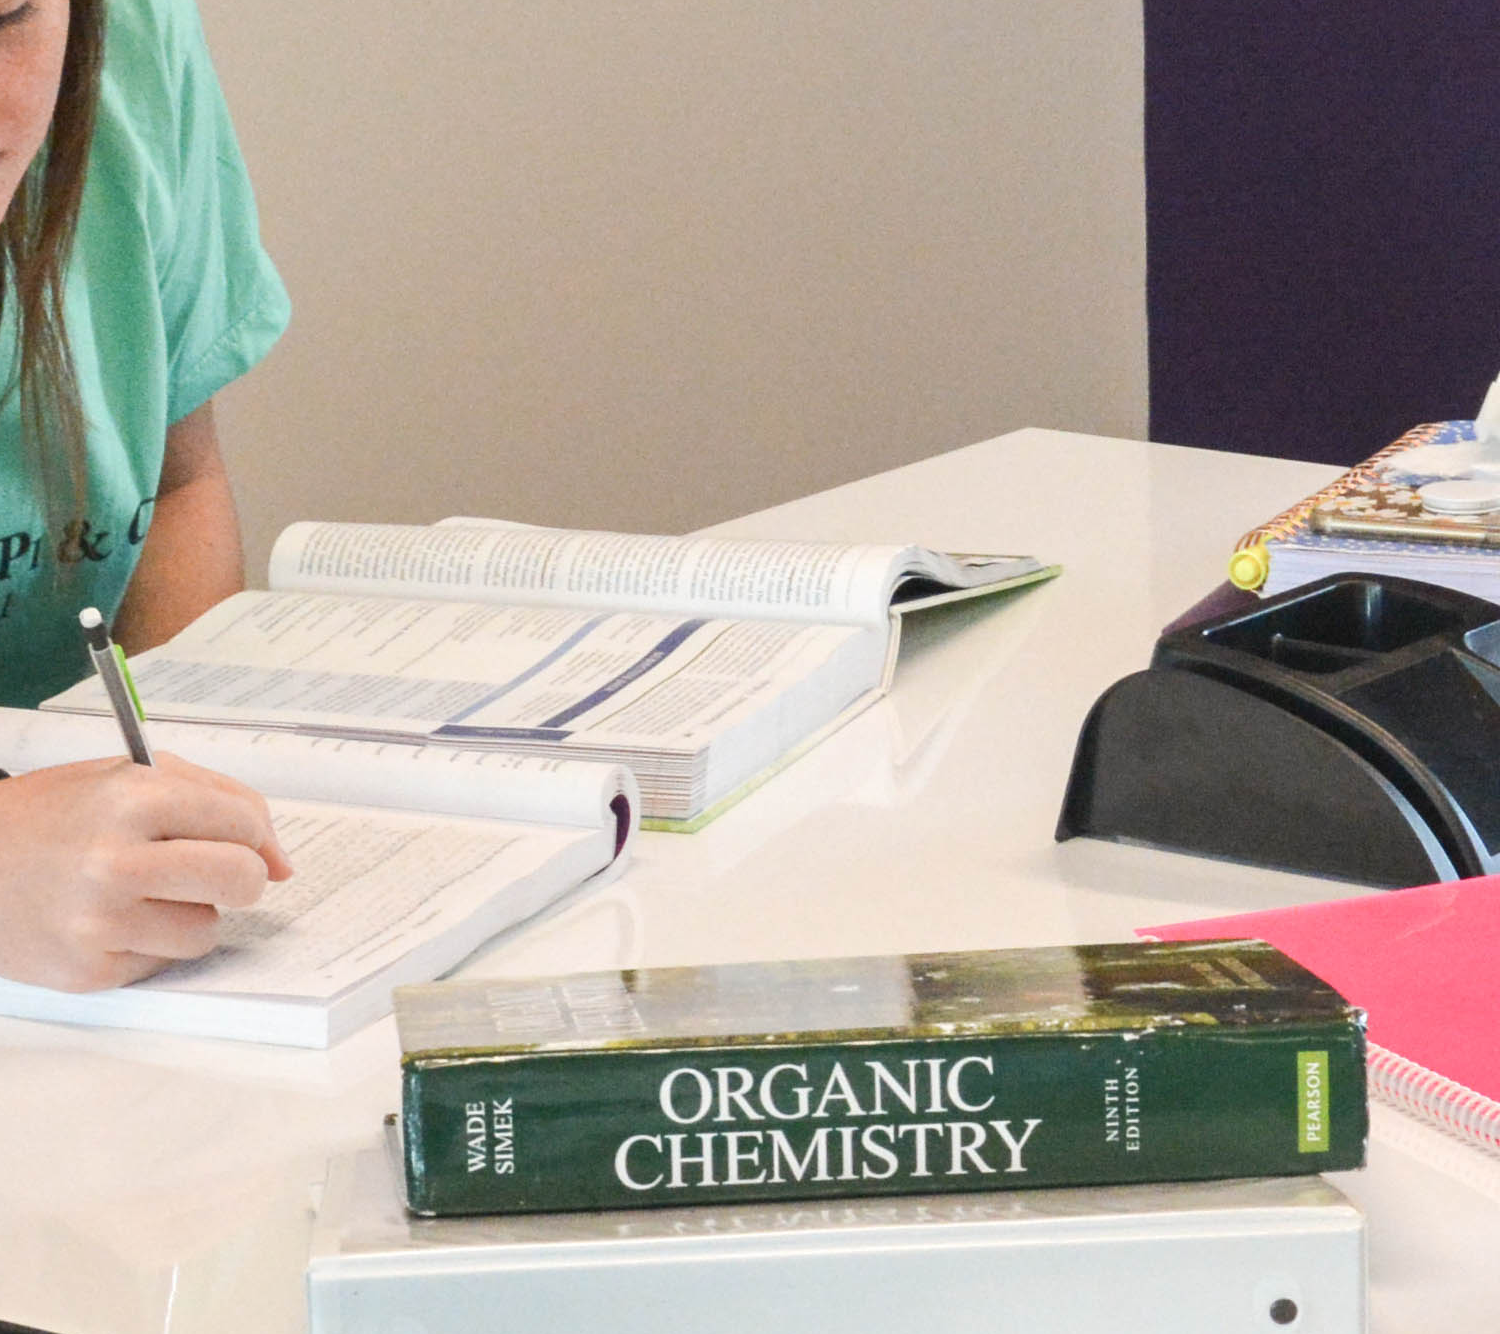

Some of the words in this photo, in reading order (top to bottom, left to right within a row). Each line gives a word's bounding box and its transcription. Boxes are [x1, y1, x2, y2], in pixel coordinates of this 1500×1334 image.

[658, 1056, 997, 1125] ORGANIC
[1104, 1077, 1120, 1143] NINTH
[1125, 1067, 1140, 1152] EDITION
[1305, 1061, 1322, 1142] PEARSON
[465, 1100, 488, 1174] WADE
[493, 1096, 515, 1175] SIMEK
[613, 1118, 1043, 1191] CHEMISTRY
